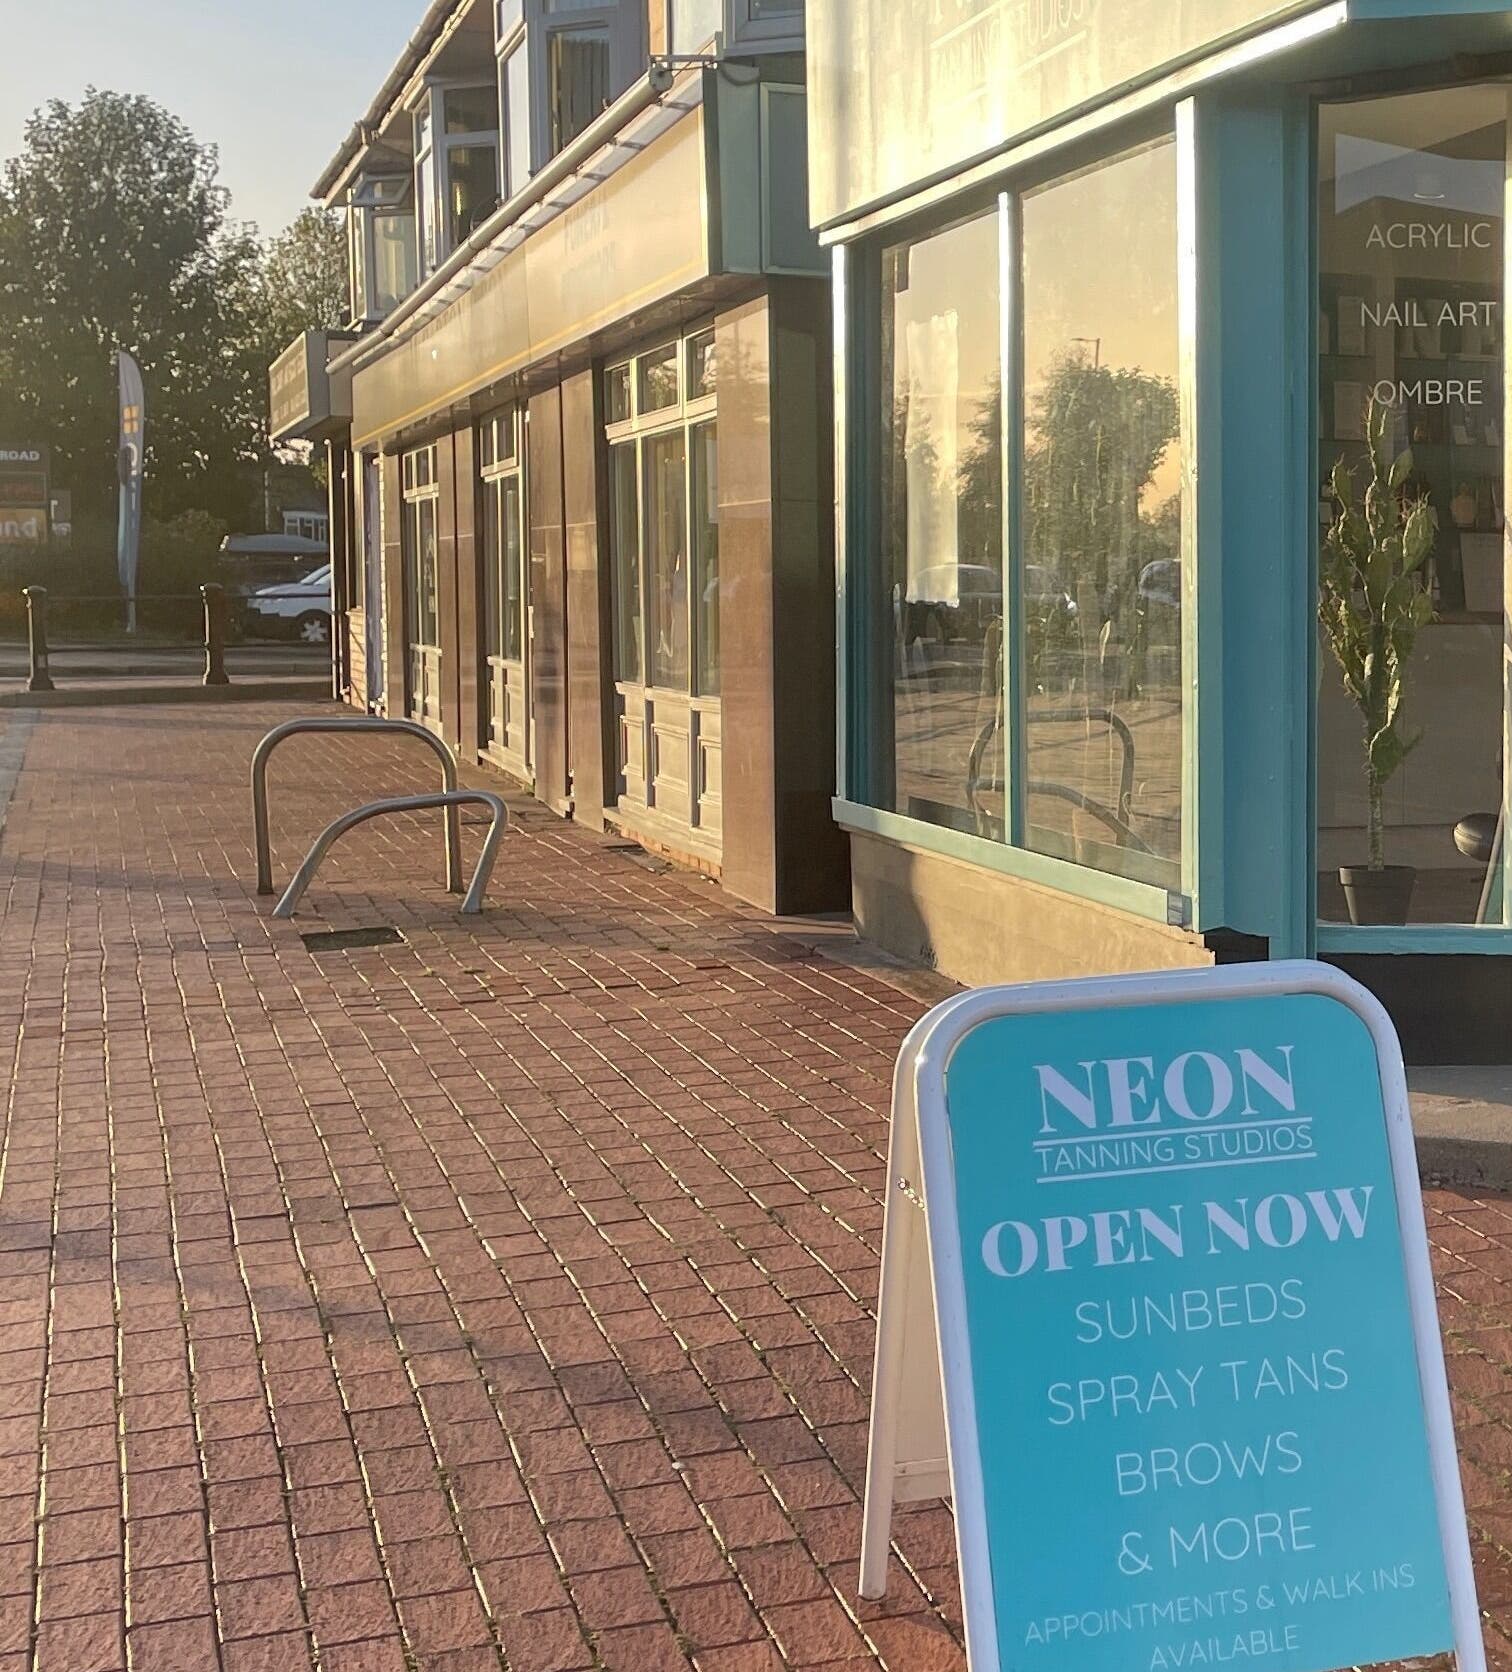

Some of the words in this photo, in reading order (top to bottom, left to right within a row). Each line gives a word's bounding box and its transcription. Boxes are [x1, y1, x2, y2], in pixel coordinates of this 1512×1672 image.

[1365, 222, 1492, 249] ACRYLIC
[1360, 300, 1428, 328] NAIL
[1436, 301, 1497, 327] ART
[1373, 379, 1484, 406] OMBRE
[1032, 1045, 1296, 1134] NEON
[1033, 1135, 1175, 1175] TANNING
[1183, 1124, 1314, 1160] STUDIOS
[980, 1204, 1185, 1278] OPEN
[1202, 1185, 1375, 1256] NOW
[1074, 1278, 1307, 1344] SUNBEDS
[1046, 1364, 1204, 1426] SPRAY
[1219, 1348, 1350, 1401] TANS
[1114, 1431, 1302, 1496] BROWS
[1117, 1531, 1153, 1576] &
[1169, 1506, 1316, 1569] MORE
[1024, 1588, 1249, 1647] APPOINTMENTS
[1255, 1584, 1276, 1610] &
[1281, 1570, 1364, 1606] WALK
[1372, 1563, 1417, 1590] INS
[1149, 1624, 1302, 1672] AVAILABLE
